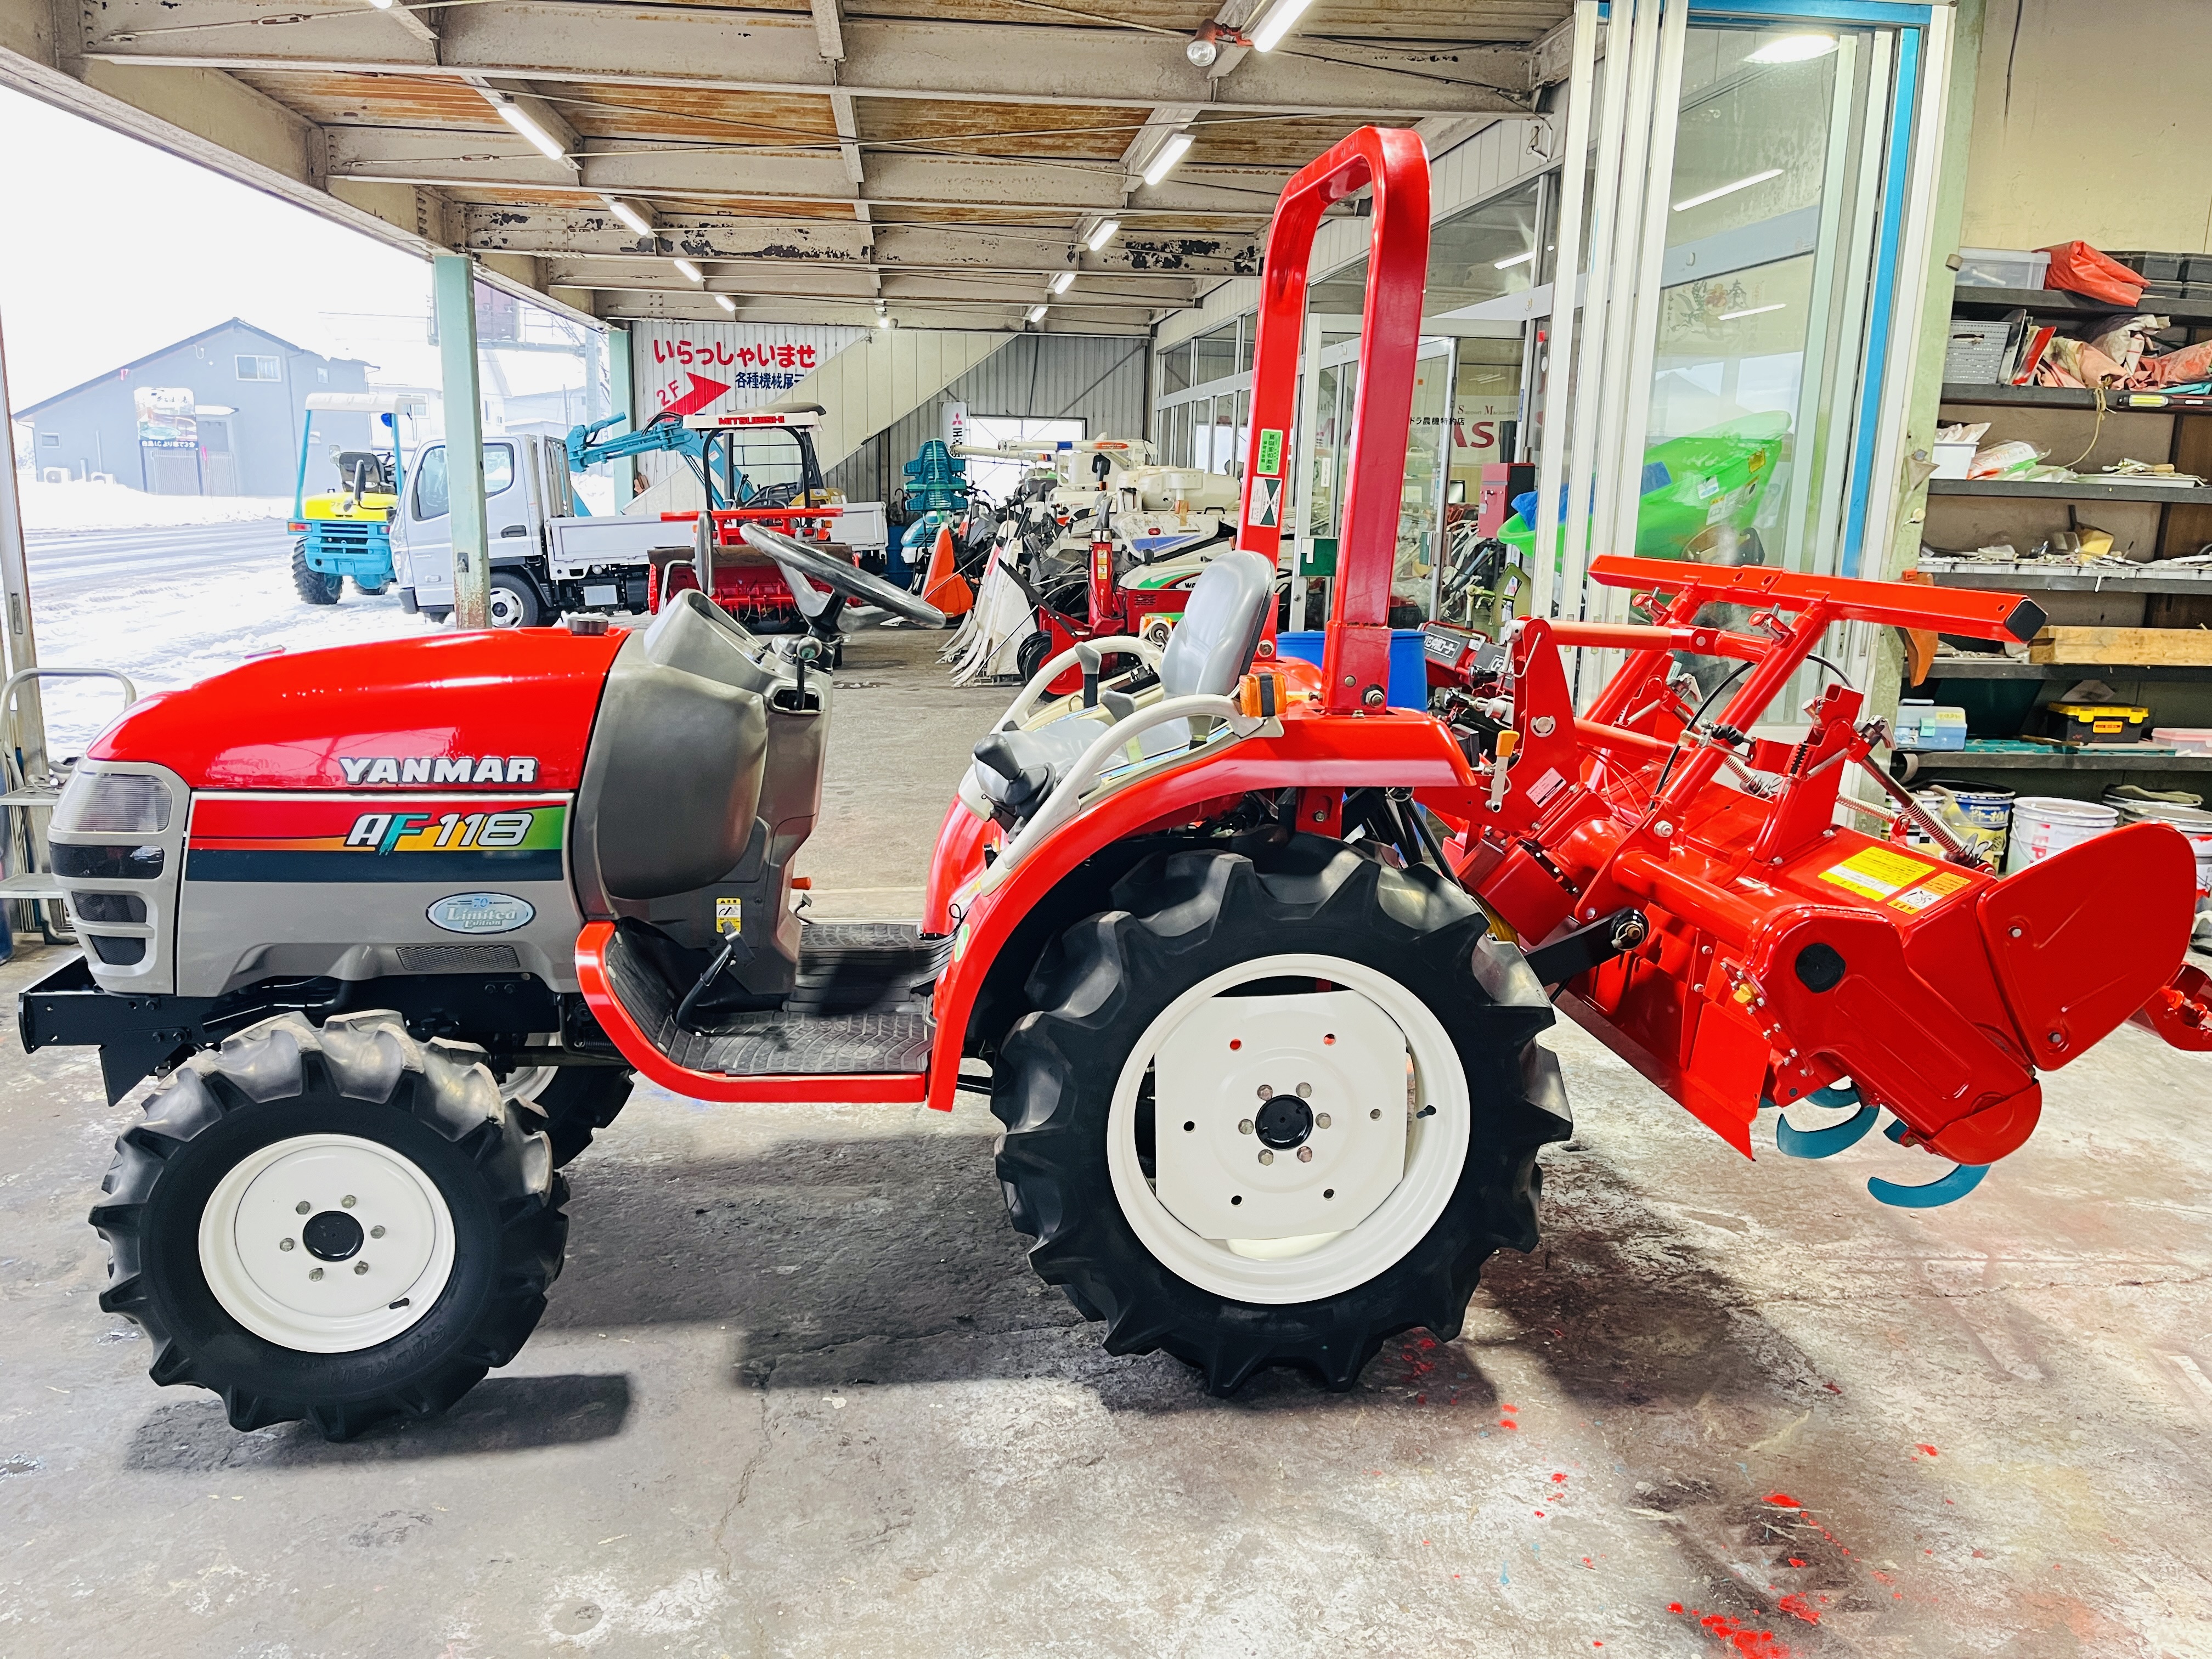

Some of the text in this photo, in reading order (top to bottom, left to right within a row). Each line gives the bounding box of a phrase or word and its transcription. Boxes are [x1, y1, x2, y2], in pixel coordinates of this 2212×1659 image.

[653, 340, 816, 368] いらっしゃいませ
[656, 380, 679, 407] 2F
[718, 415, 785, 426] MITSUBISHI
[339, 758, 537, 783] YANMAR
[446, 907, 517, 921] Limited
[464, 920, 501, 928] Edition
